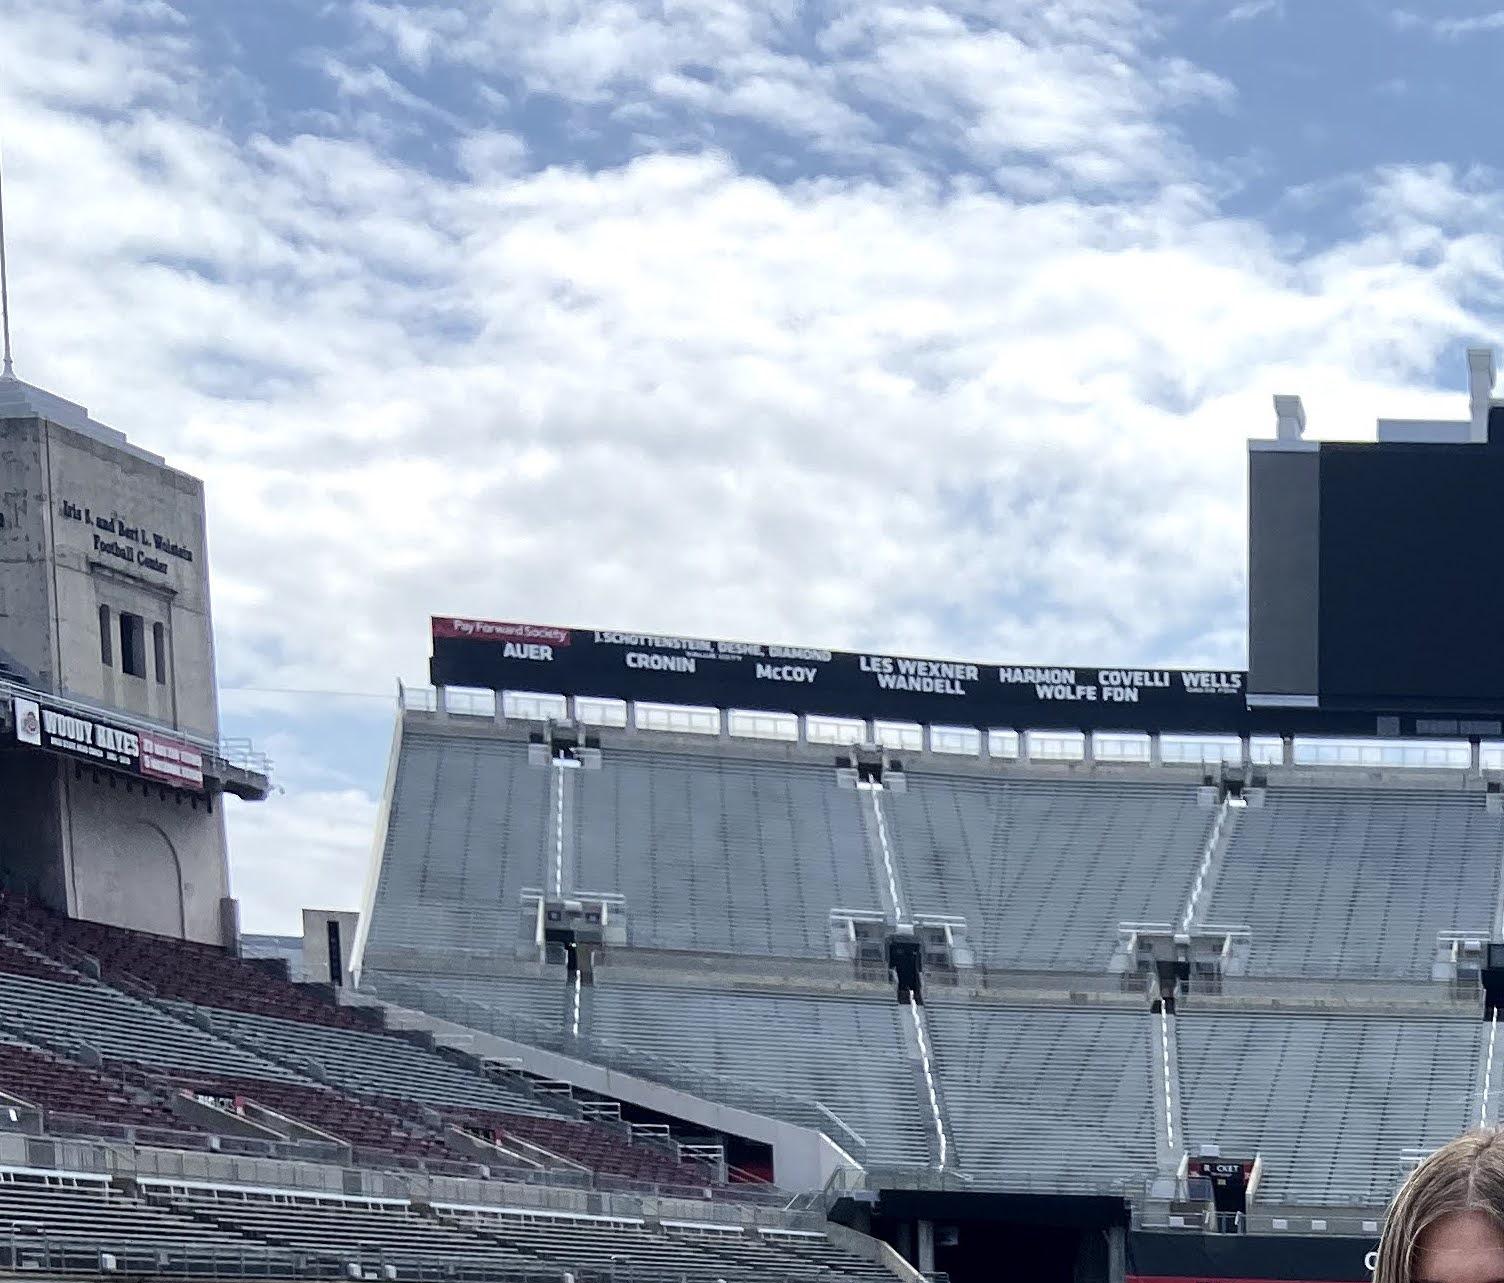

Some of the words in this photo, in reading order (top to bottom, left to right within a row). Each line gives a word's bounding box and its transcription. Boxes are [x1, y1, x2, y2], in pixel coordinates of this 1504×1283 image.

[503, 641, 554, 661] AUER
[626, 651, 697, 673] CRONIN
[860, 656, 893, 673] LES
[898, 659, 979, 681] WEXNER
[755, 662, 818, 683] McCOY
[999, 667, 1075, 684] HARMON
[1098, 670, 1170, 687] COVELLI
[1181, 671, 1242, 688] WELLS
[877, 674, 966, 695] WANDELL
[1035, 684, 1097, 701] WOLFE
[1102, 687, 1139, 702] FDN
